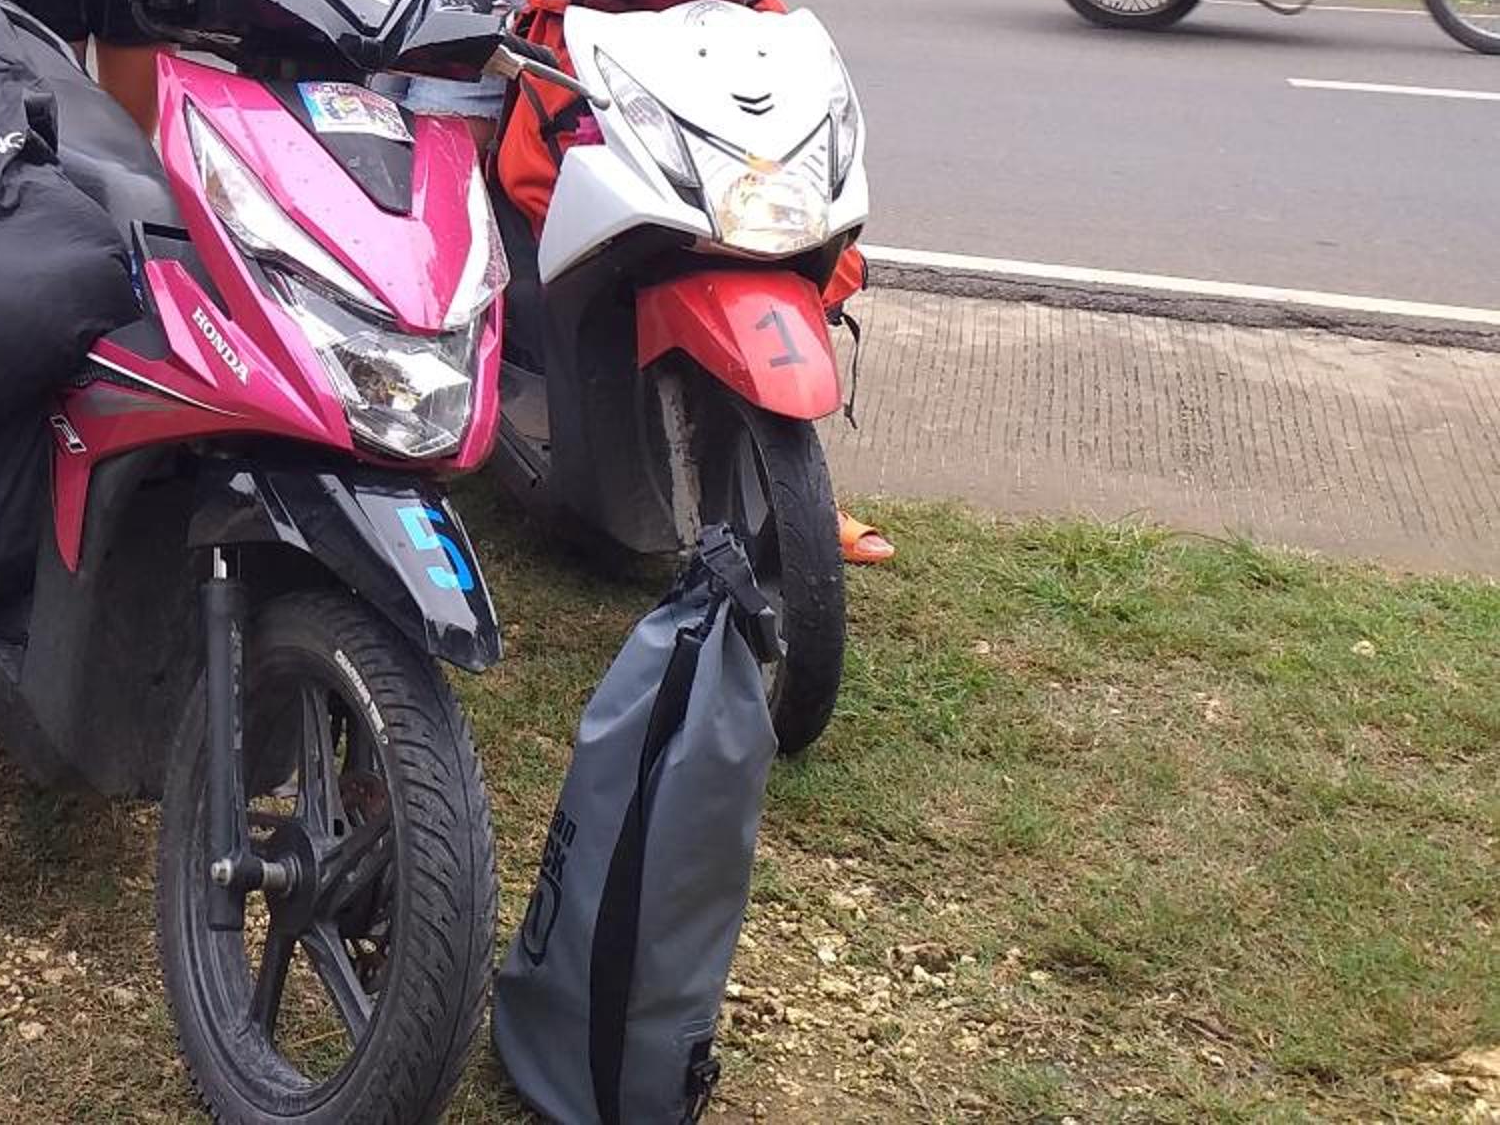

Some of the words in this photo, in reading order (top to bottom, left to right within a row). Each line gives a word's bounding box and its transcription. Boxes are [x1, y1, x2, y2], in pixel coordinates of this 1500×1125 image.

[190, 306, 251, 388] HONDA
[753, 308, 808, 368] 1
[395, 505, 476, 593] 5
